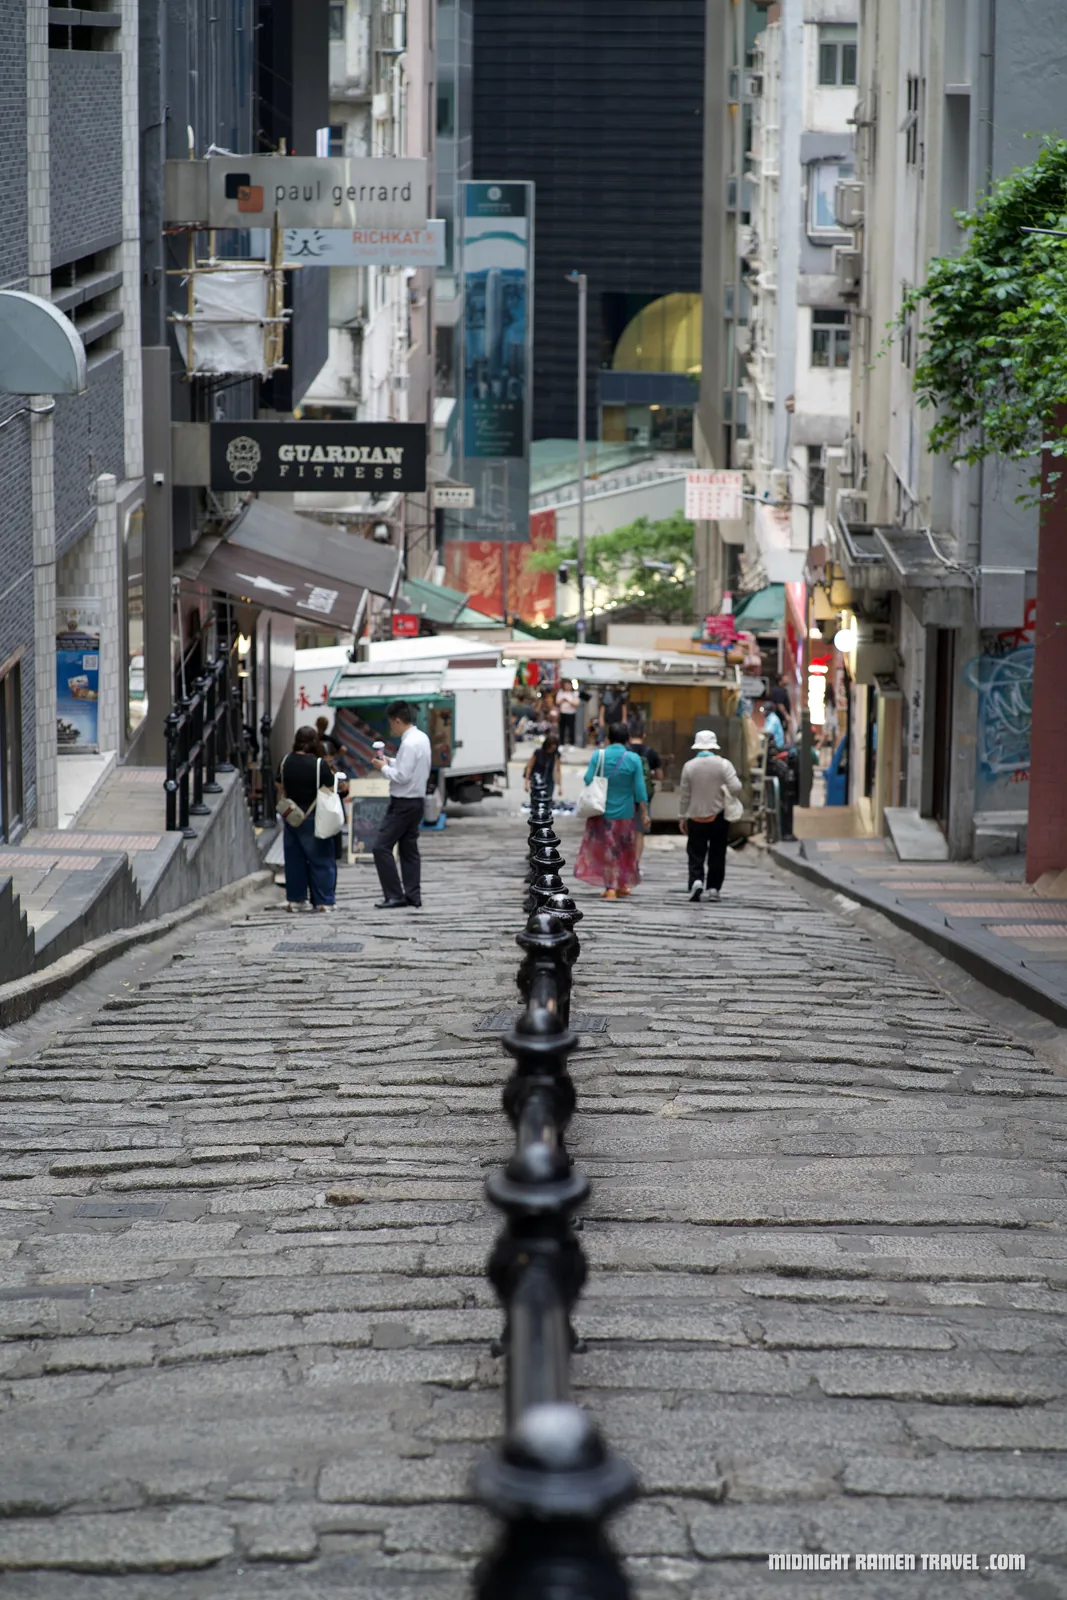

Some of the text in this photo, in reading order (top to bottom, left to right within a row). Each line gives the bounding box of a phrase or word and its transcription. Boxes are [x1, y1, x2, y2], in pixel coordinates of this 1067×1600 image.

[275, 180, 412, 207] paul gerrard
[352, 230, 421, 245] RICHKAT
[278, 444, 404, 464] GUARDIAN
[279, 465, 403, 480] FITNESS
